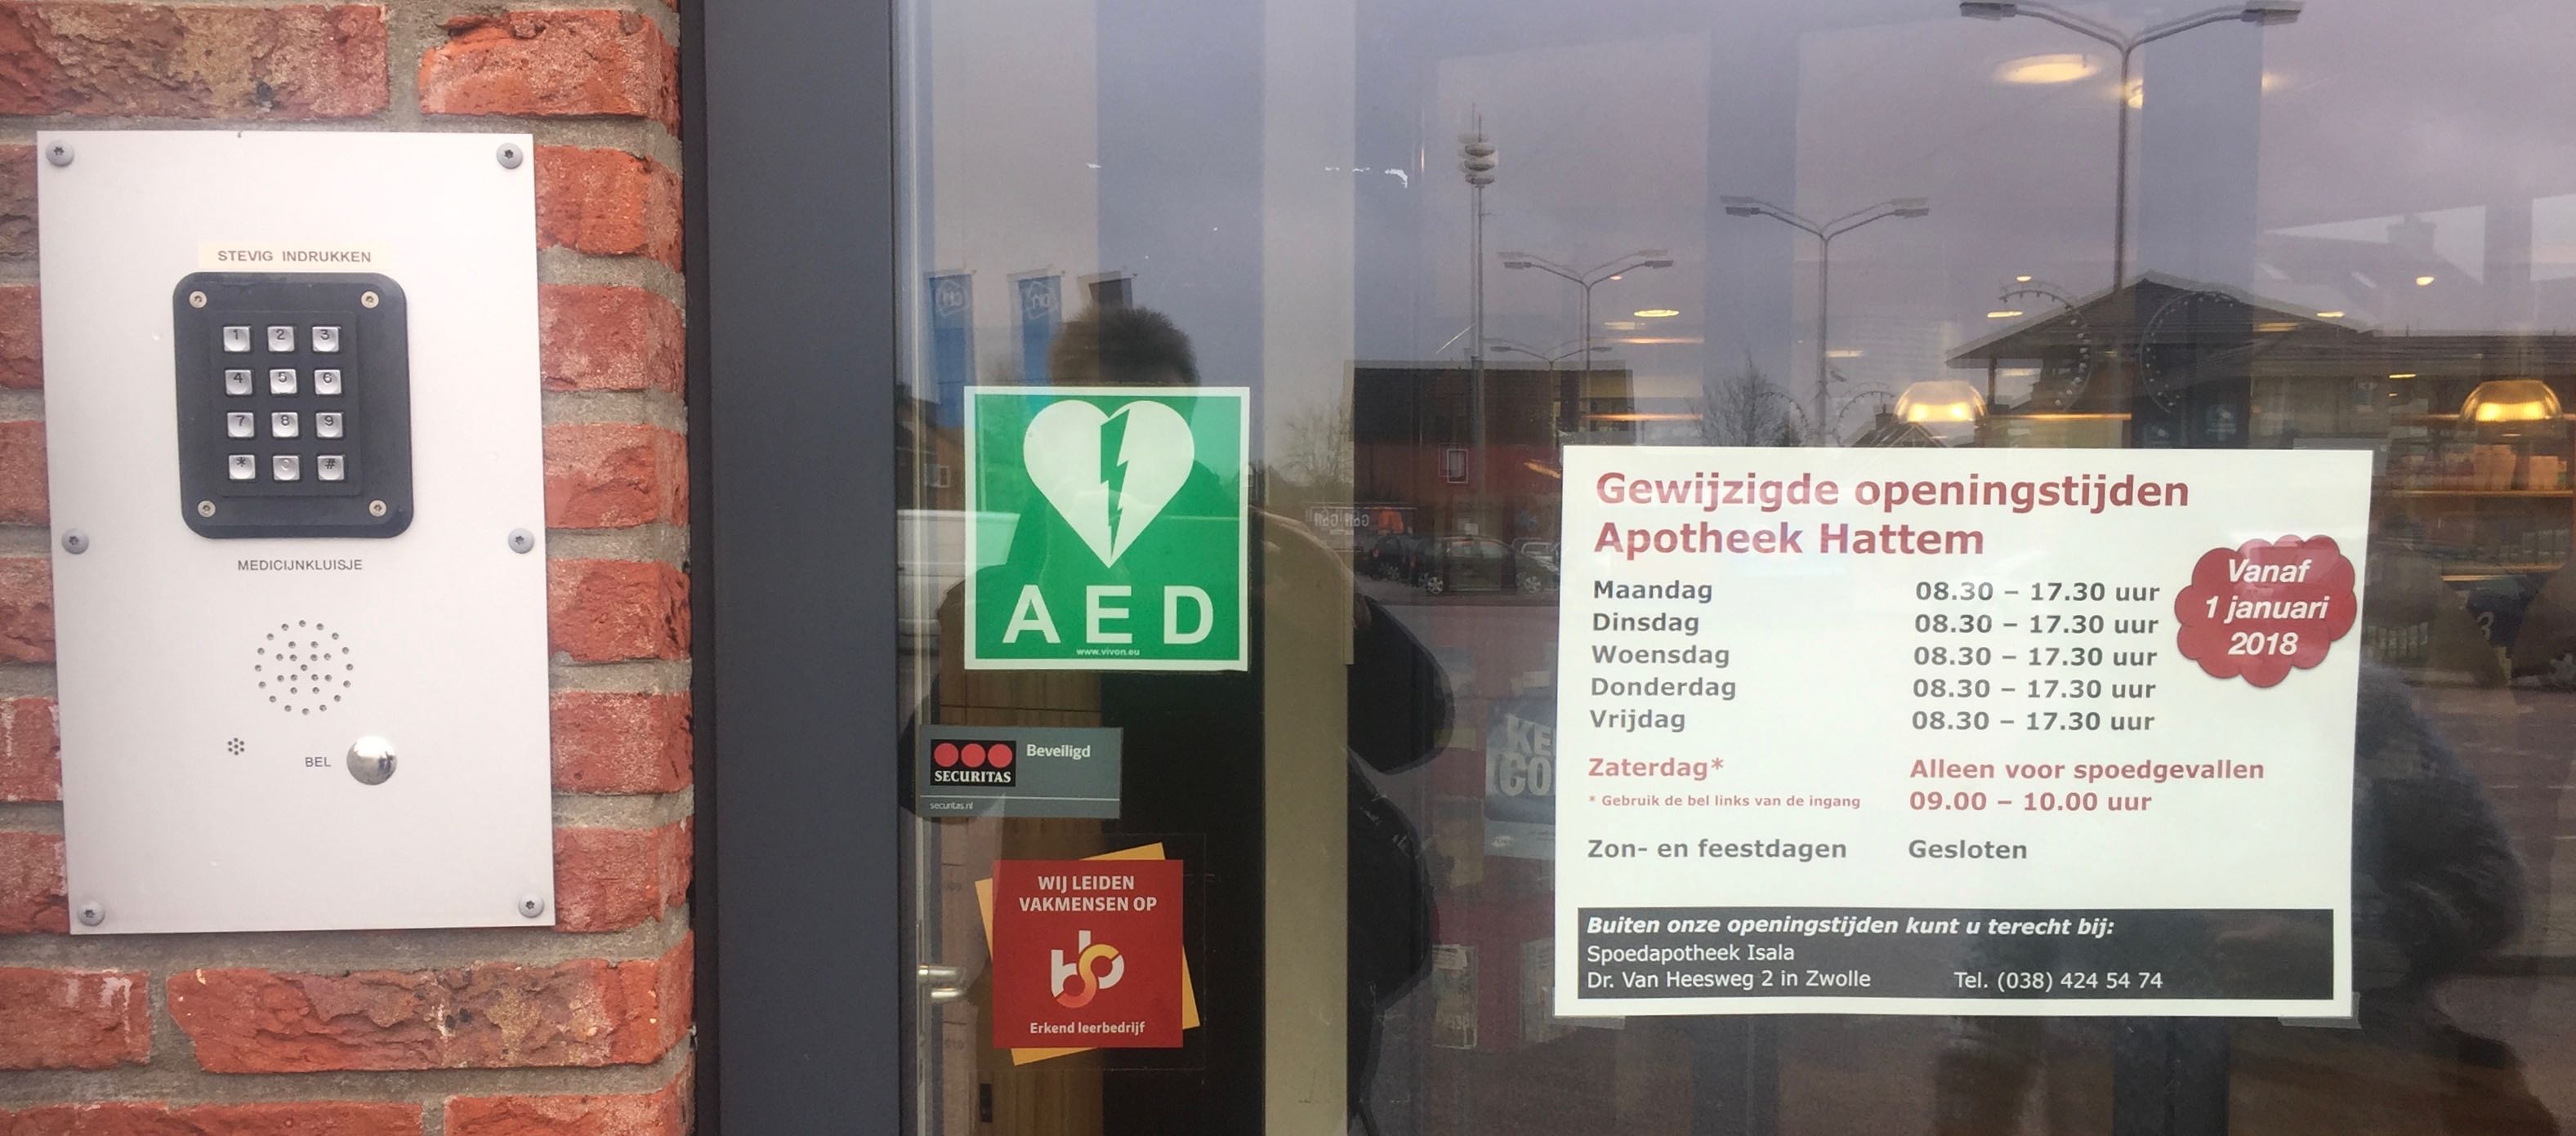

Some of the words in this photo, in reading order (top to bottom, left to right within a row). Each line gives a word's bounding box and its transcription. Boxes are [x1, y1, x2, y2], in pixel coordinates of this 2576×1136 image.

[217, 250, 274, 262] STEVIG
[282, 251, 371, 263] INDRUKKEN
[233, 329, 239, 341] 1
[275, 328, 286, 341] 2
[320, 329, 330, 341] 3
[233, 372, 243, 384] 4
[278, 372, 288, 383] 5
[322, 372, 333, 384] 6
[235, 415, 246, 426] 7
[280, 415, 290, 426] 8
[324, 415, 334, 426] 9
[1596, 471, 1838, 513] Gewijzigde
[1855, 473, 2189, 515] openingstijden
[1594, 521, 1803, 561] Apotheek
[1819, 523, 1984, 555] Hattem
[237, 559, 363, 571] MEDICIJNKLUISJE
[2229, 558, 2312, 585] Vanaf
[1594, 579, 1712, 604] Maandag
[1916, 581, 1993, 601] 08.30
[2031, 581, 2105, 602] 17.30
[2115, 586, 2160, 602] uur
[1002, 584, 1214, 644] AED
[2206, 595, 2219, 618] 1
[2223, 595, 2330, 624] januari
[1593, 612, 1699, 636] Dinsdag
[1915, 613, 1993, 634] 08.30
[2030, 614, 2105, 635] 17.30
[2114, 619, 2159, 635] uur
[2227, 631, 2299, 656] 2018
[1591, 644, 1730, 669] Woensdag
[1913, 646, 1992, 666] 08.30
[2029, 647, 2103, 666] 17.30
[2113, 652, 2158, 666] uur
[1591, 676, 1736, 702] Donderdag
[1913, 678, 1990, 698] 08.30
[2028, 679, 2102, 699] 17.30
[2111, 684, 2157, 699] uur
[1589, 709, 1685, 733] Vrijdag
[1912, 711, 1989, 731] 08.30
[2027, 711, 2101, 731] 17.30
[2110, 716, 2155, 731] uur
[305, 756, 332, 768] BEL
[1026, 743, 1091, 760] Beveiligd
[935, 770, 1011, 783] SECURITAS
[1909, 758, 1994, 779] Alleen
[2005, 764, 2065, 779] voor
[2074, 759, 2264, 784] spoedgevallen
[1601, 795, 1660, 807] Gebruik
[1664, 795, 1683, 806] de
[1687, 795, 1710, 807] bel
[1715, 795, 1750, 807] links
[1754, 797, 1781, 807] van
[1786, 795, 1805, 807] de
[1809, 795, 1860, 810] ingang
[1909, 791, 1987, 811] 09.00
[2024, 791, 2098, 812] 10.00
[2108, 796, 2153, 812] uur
[1587, 839, 1648, 858] Zon-
[1657, 843, 1688, 858] en
[1698, 838, 1846, 863] feestdagen
[1909, 840, 2027, 859] Gesloten
[1038, 875, 1067, 894] WIJ
[1072, 875, 1135, 890] LEIDEN
[1019, 897, 1129, 912] VAKMENSEN
[1133, 896, 1158, 911] OP
[1587, 915, 1661, 934] Buiten
[1667, 919, 1721, 933] onze
[1727, 915, 1899, 937] openingstijden
[1905, 916, 1961, 934] kunt
[1966, 921, 1981, 935] u
[1988, 918, 2072, 935] terecht
[2077, 917, 2114, 939] bij:
[1587, 943, 1740, 966] Spoedapotheek
[1747, 943, 1795, 961] Isala
[1587, 971, 1614, 988] Dr.
[1621, 971, 1659, 988] Van
[1666, 970, 1754, 991] Heesweg
[1761, 969, 1774, 987] 2
[1781, 969, 1798, 987] in
[1806, 969, 1871, 987] Zwolle
[1953, 971, 1989, 989] Tel.
[1998, 971, 2053, 993] (038)
[2060, 972, 2099, 989] 424
[2106, 972, 2131, 989] 54
[2138, 972, 2163, 989] 74
[1029, 1021, 1075, 1034] Erkend
[1078, 1021, 1145, 1036] leerbedrijf
